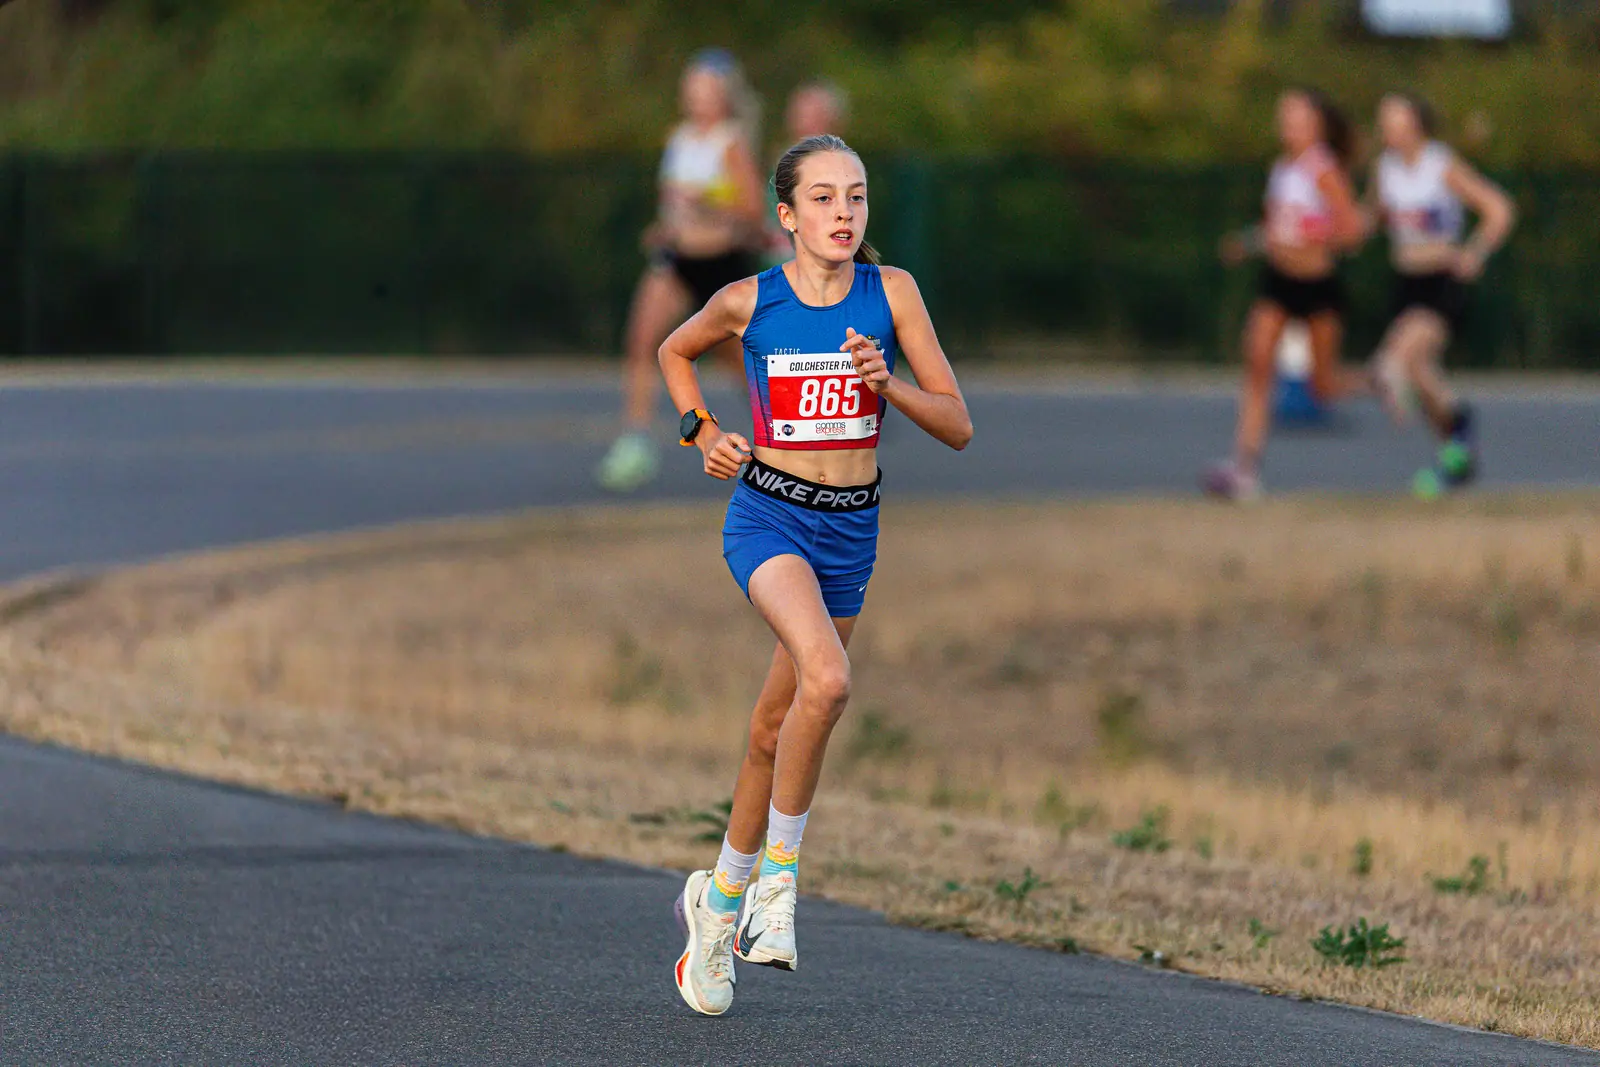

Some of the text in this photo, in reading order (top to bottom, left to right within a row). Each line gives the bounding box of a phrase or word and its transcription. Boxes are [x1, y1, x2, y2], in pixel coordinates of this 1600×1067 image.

[789, 360, 839, 372] COLCHESTER
[798, 377, 862, 418] 865
[815, 421, 846, 430] comms
[815, 427, 847, 436] express
[748, 465, 814, 503] NIKE
[812, 489, 869, 508] PRO
